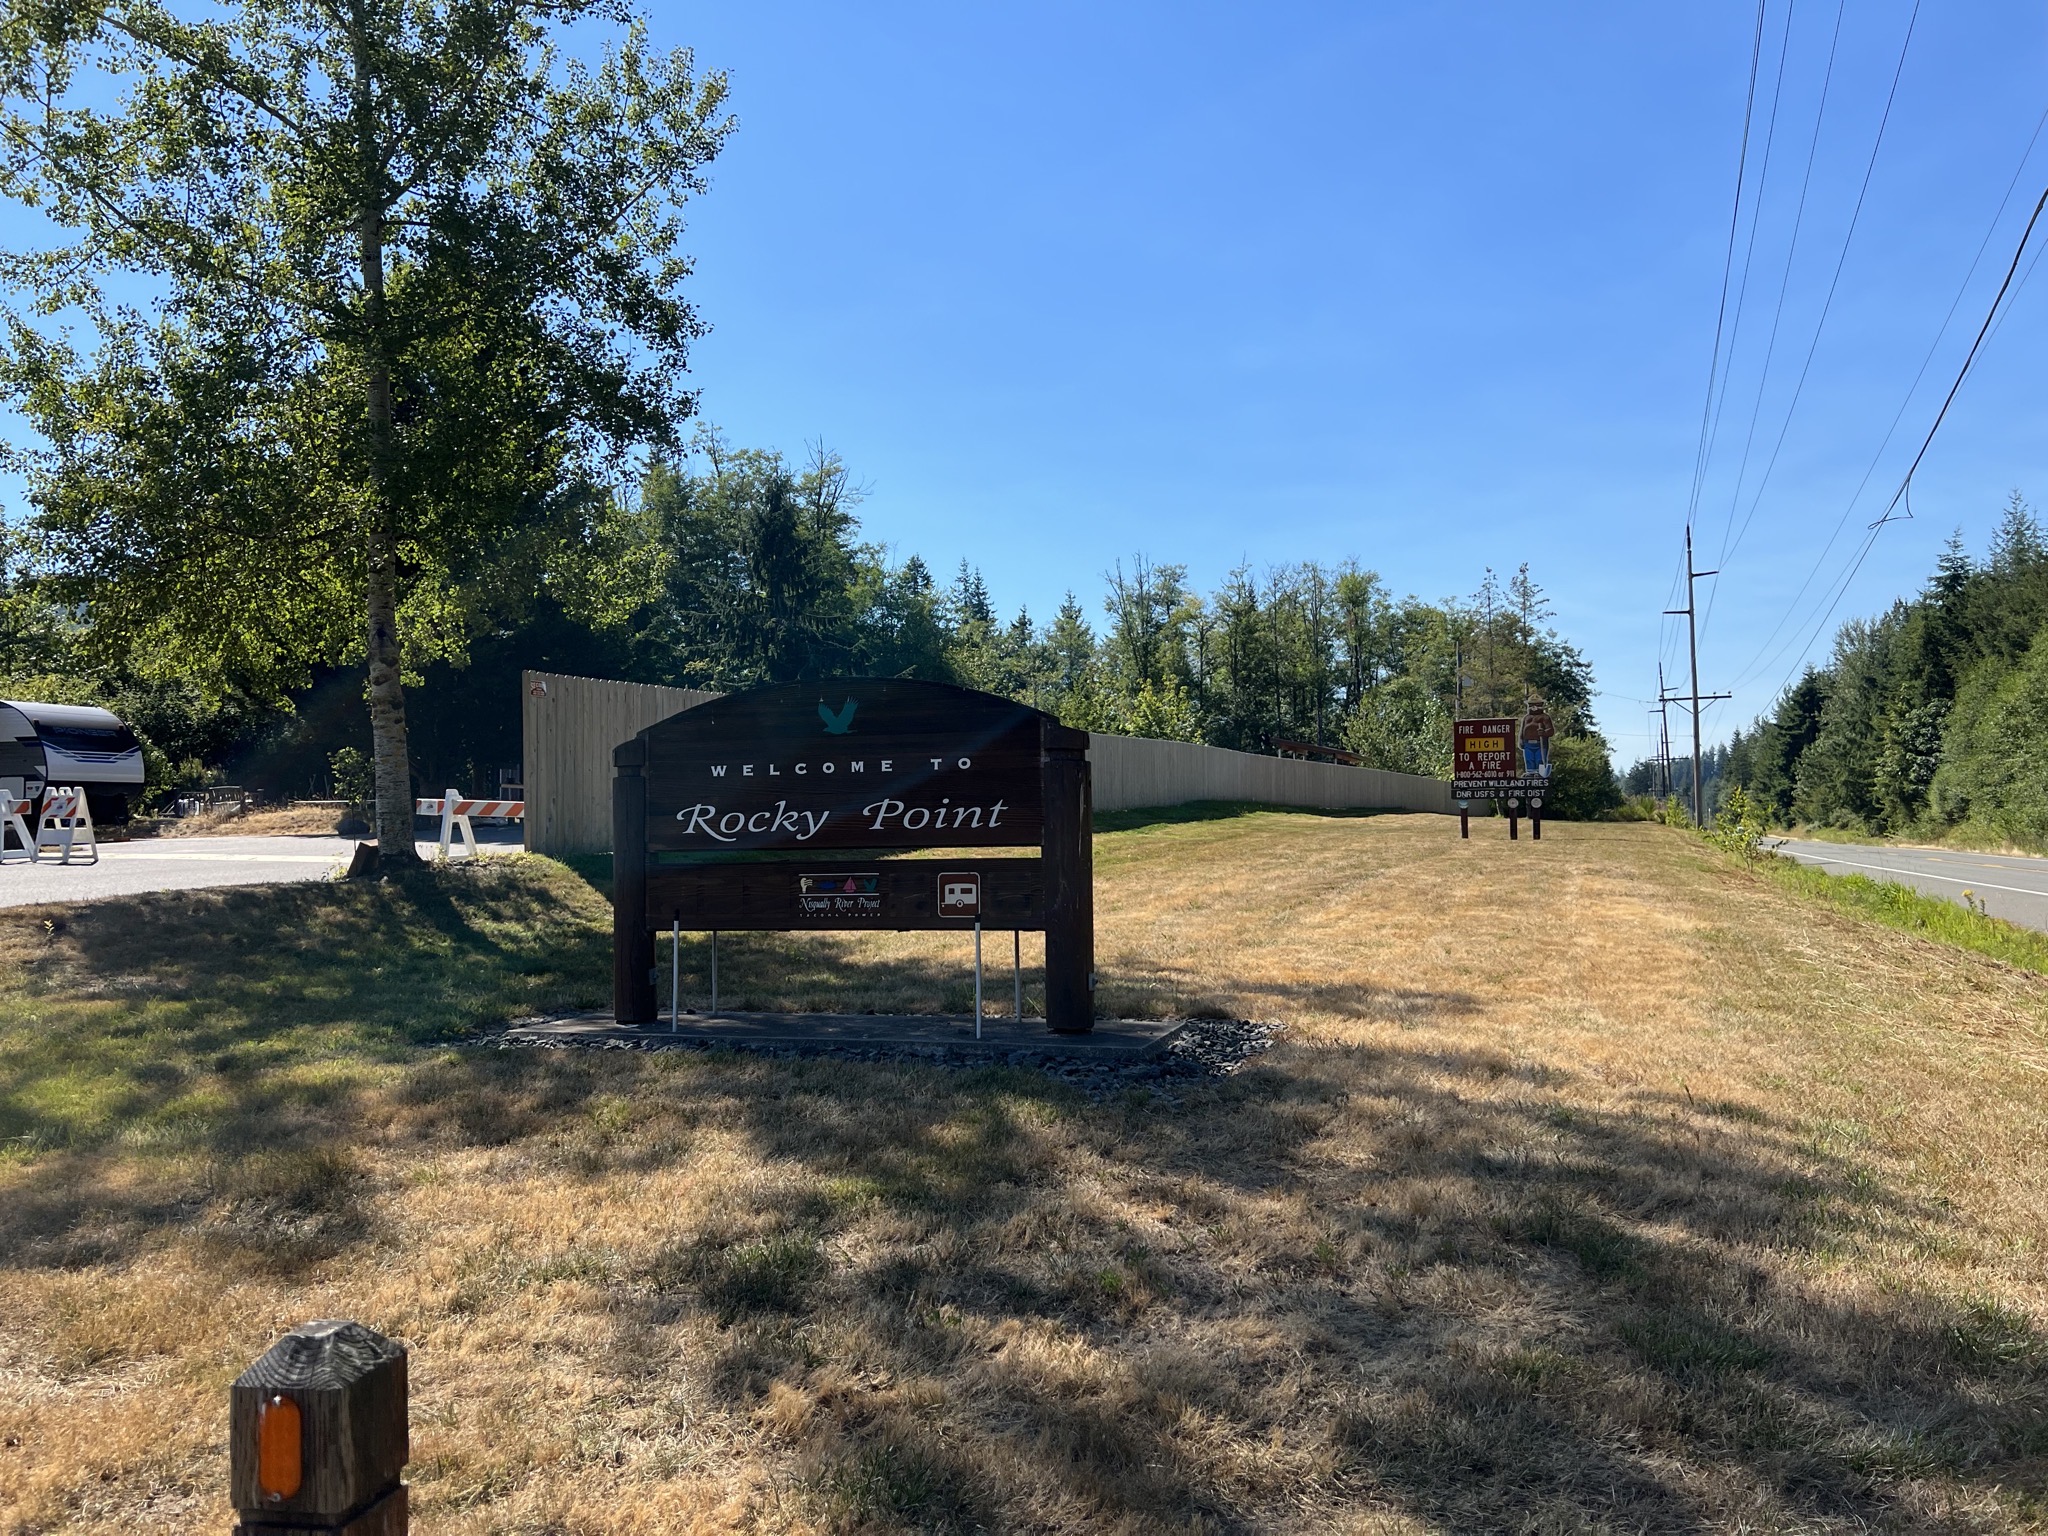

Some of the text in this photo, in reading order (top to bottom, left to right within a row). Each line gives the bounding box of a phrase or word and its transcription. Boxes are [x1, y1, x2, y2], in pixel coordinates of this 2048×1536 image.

[1458, 724, 1510, 735] FIRE DANGER
[1469, 740, 1499, 749] HIGH
[1459, 752, 1511, 761] TO REPORT
[710, 757, 972, 777] WELCOME TO
[1469, 761, 1501, 770] A FIRE
[1506, 770, 1515, 778] 911
[1453, 780, 1487, 788] PREVENT
[1526, 779, 1549, 787] FIRES
[1474, 790, 1495, 798] USFS
[1527, 789, 1546, 797] DIST
[676, 798, 1009, 842] Rocky Point
[799, 897, 881, 912] Nisqually River Project
